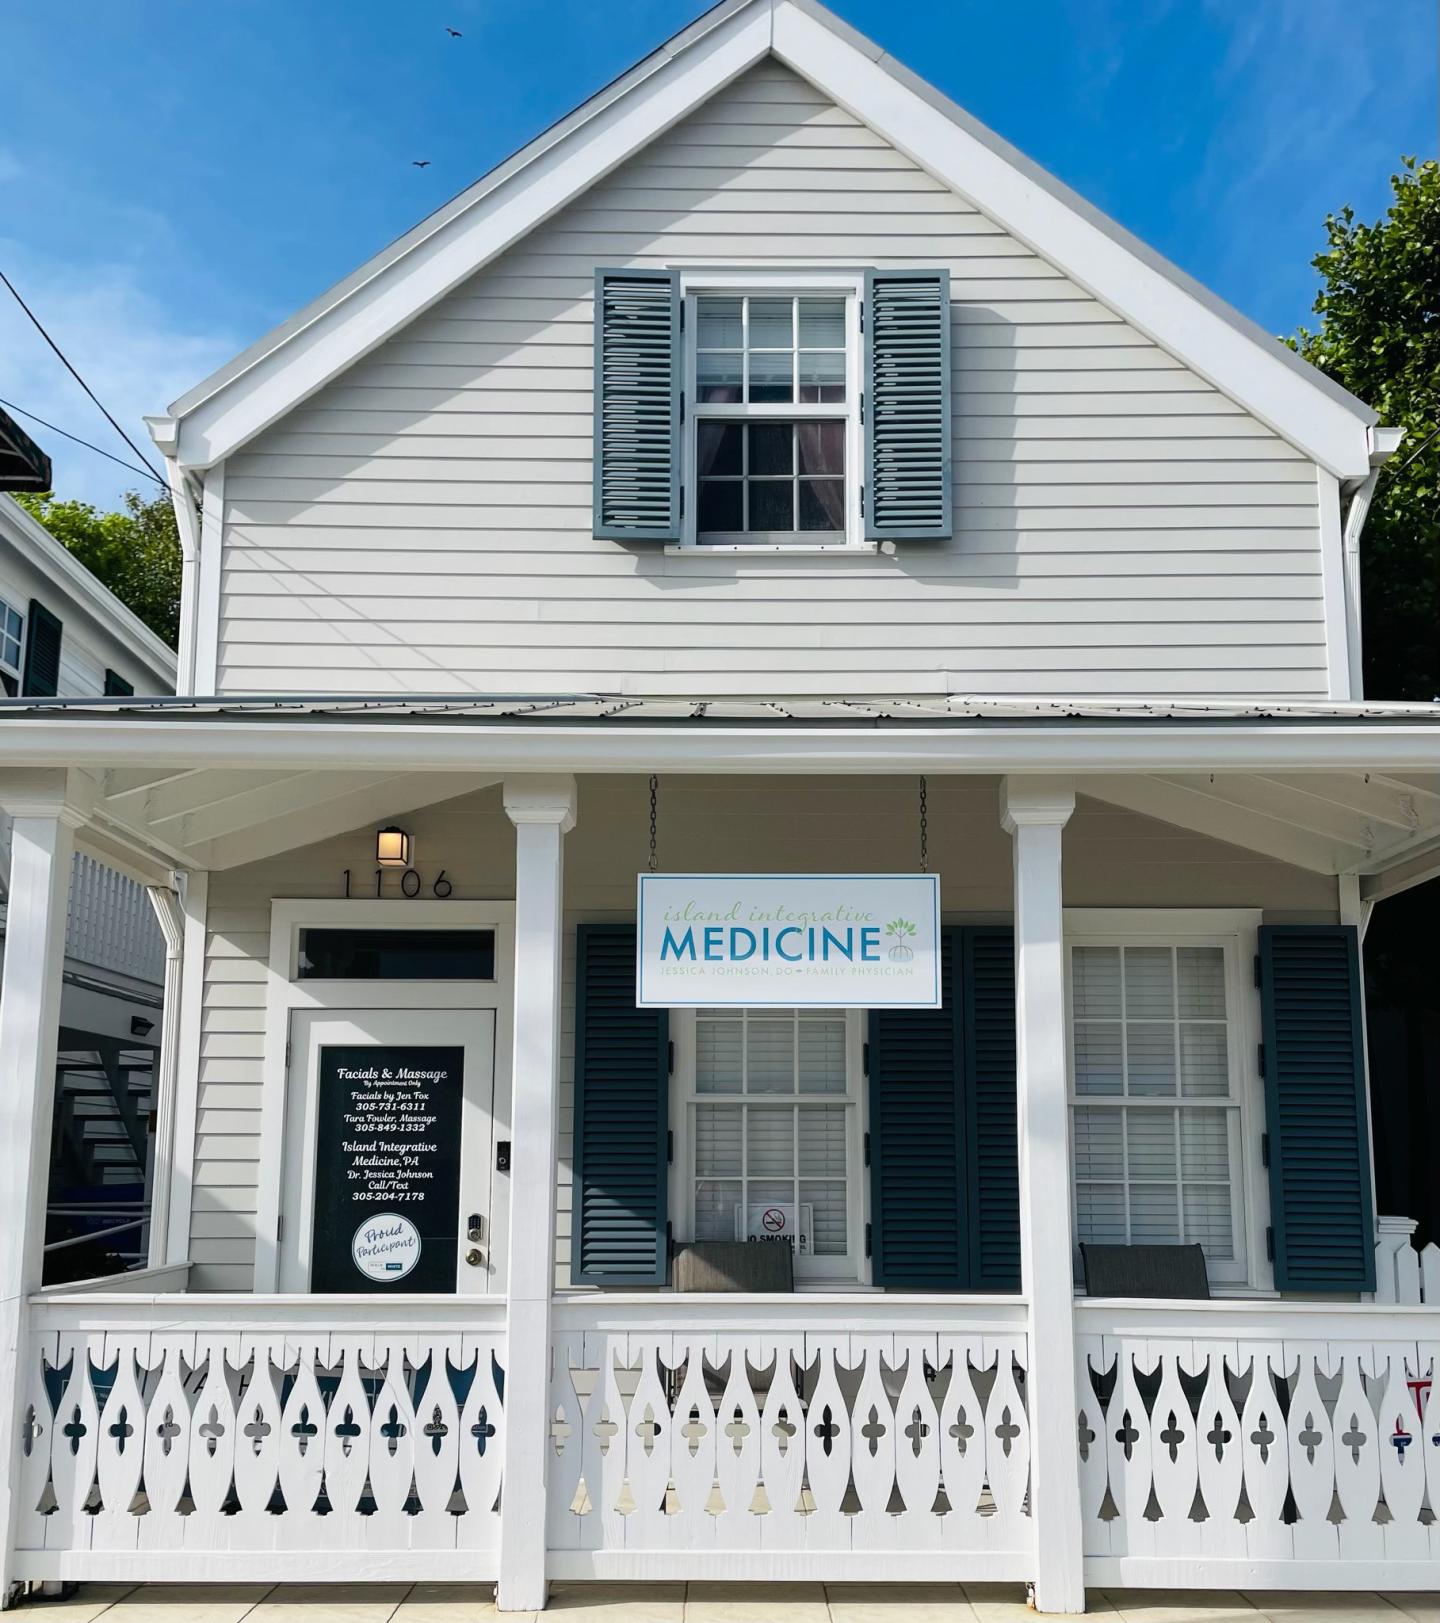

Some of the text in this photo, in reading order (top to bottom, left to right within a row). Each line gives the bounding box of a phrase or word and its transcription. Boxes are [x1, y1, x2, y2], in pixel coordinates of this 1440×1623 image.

[343, 869, 452, 898] 1106
[664, 900, 874, 933] island integrative
[660, 925, 881, 961] MEDICINE
[660, 966, 706, 976] JESSICA
[806, 966, 846, 976] FAMILY
[851, 966, 914, 976] PHYSICIAN
[337, 1067, 448, 1083] Facials & Massage
[363, 1079, 421, 1088] By Appointment Only
[350, 1091, 430, 1103] Facials by Jen Fox
[355, 1102, 426, 1111] 305-731-6311
[343, 1114, 365, 1123] Tara
[398, 1114, 437, 1125] Massage
[354, 1123, 426, 1132] 305-849-1332
[342, 1140, 438, 1155] Island Integrative
[402, 1156, 420, 1166] PA
[346, 1169, 434, 1180] Dr. Jessica Johnson
[368, 1181, 409, 1190] Call/Text
[351, 1192, 426, 1201] 305-204-7178
[364, 1223, 404, 1243] Proud
[357, 1236, 416, 1258] Participant
